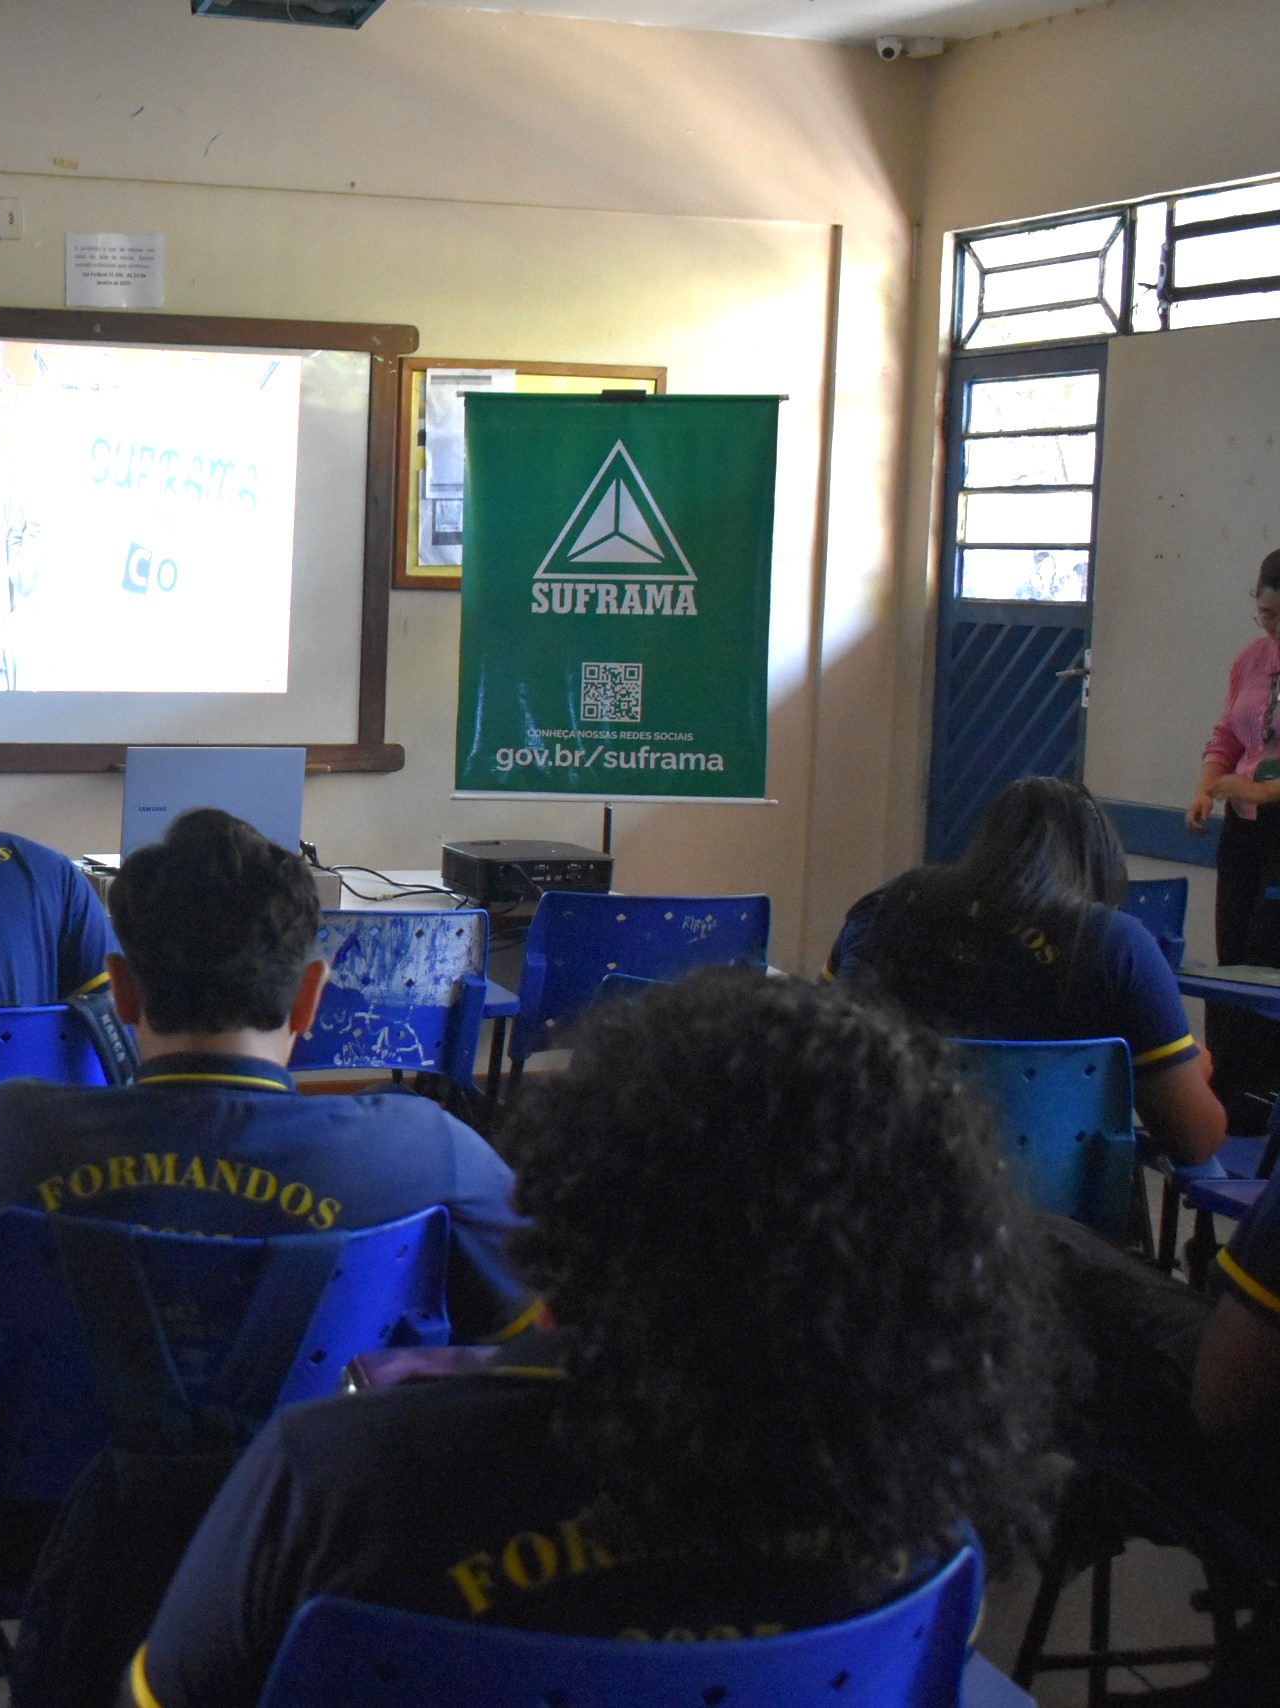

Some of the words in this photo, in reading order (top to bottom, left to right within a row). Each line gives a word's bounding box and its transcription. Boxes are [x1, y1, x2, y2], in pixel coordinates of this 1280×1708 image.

[531, 582, 698, 616] SUFRAMA
[527, 729, 575, 741] CONHEÇA
[578, 730, 618, 740] NOSSAS
[620, 731, 652, 740] REDES
[654, 732, 694, 742] SOCIAIS
[496, 743, 724, 772] gov.br/suframa
[37, 1152, 342, 1229] FORMANDOS
